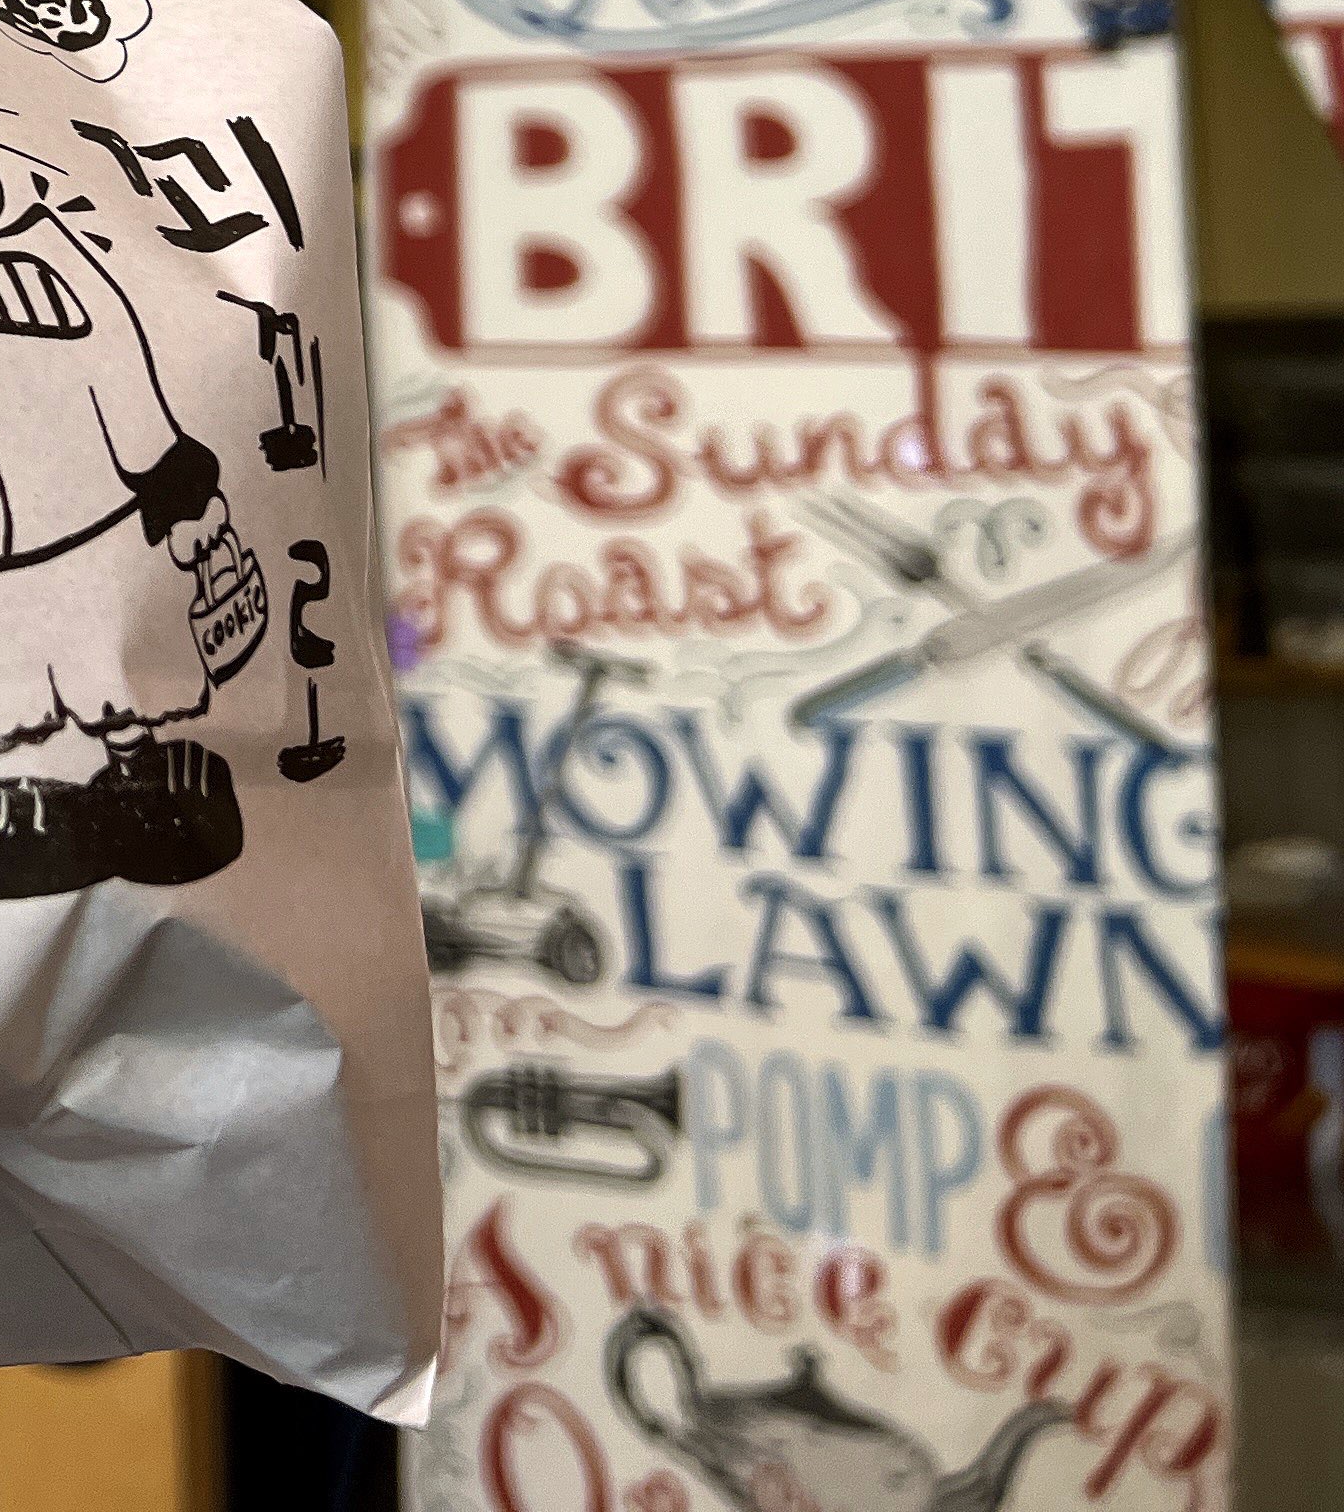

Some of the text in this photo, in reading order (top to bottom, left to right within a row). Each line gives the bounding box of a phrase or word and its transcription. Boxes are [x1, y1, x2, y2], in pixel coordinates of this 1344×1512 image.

[552, 361, 1158, 560] Sunday
[392, 506, 832, 648] Roast
[397, 693, 1222, 903] MOWING
[614, 850, 1227, 1056] LAWN
[689, 1040, 986, 1263] POMP
